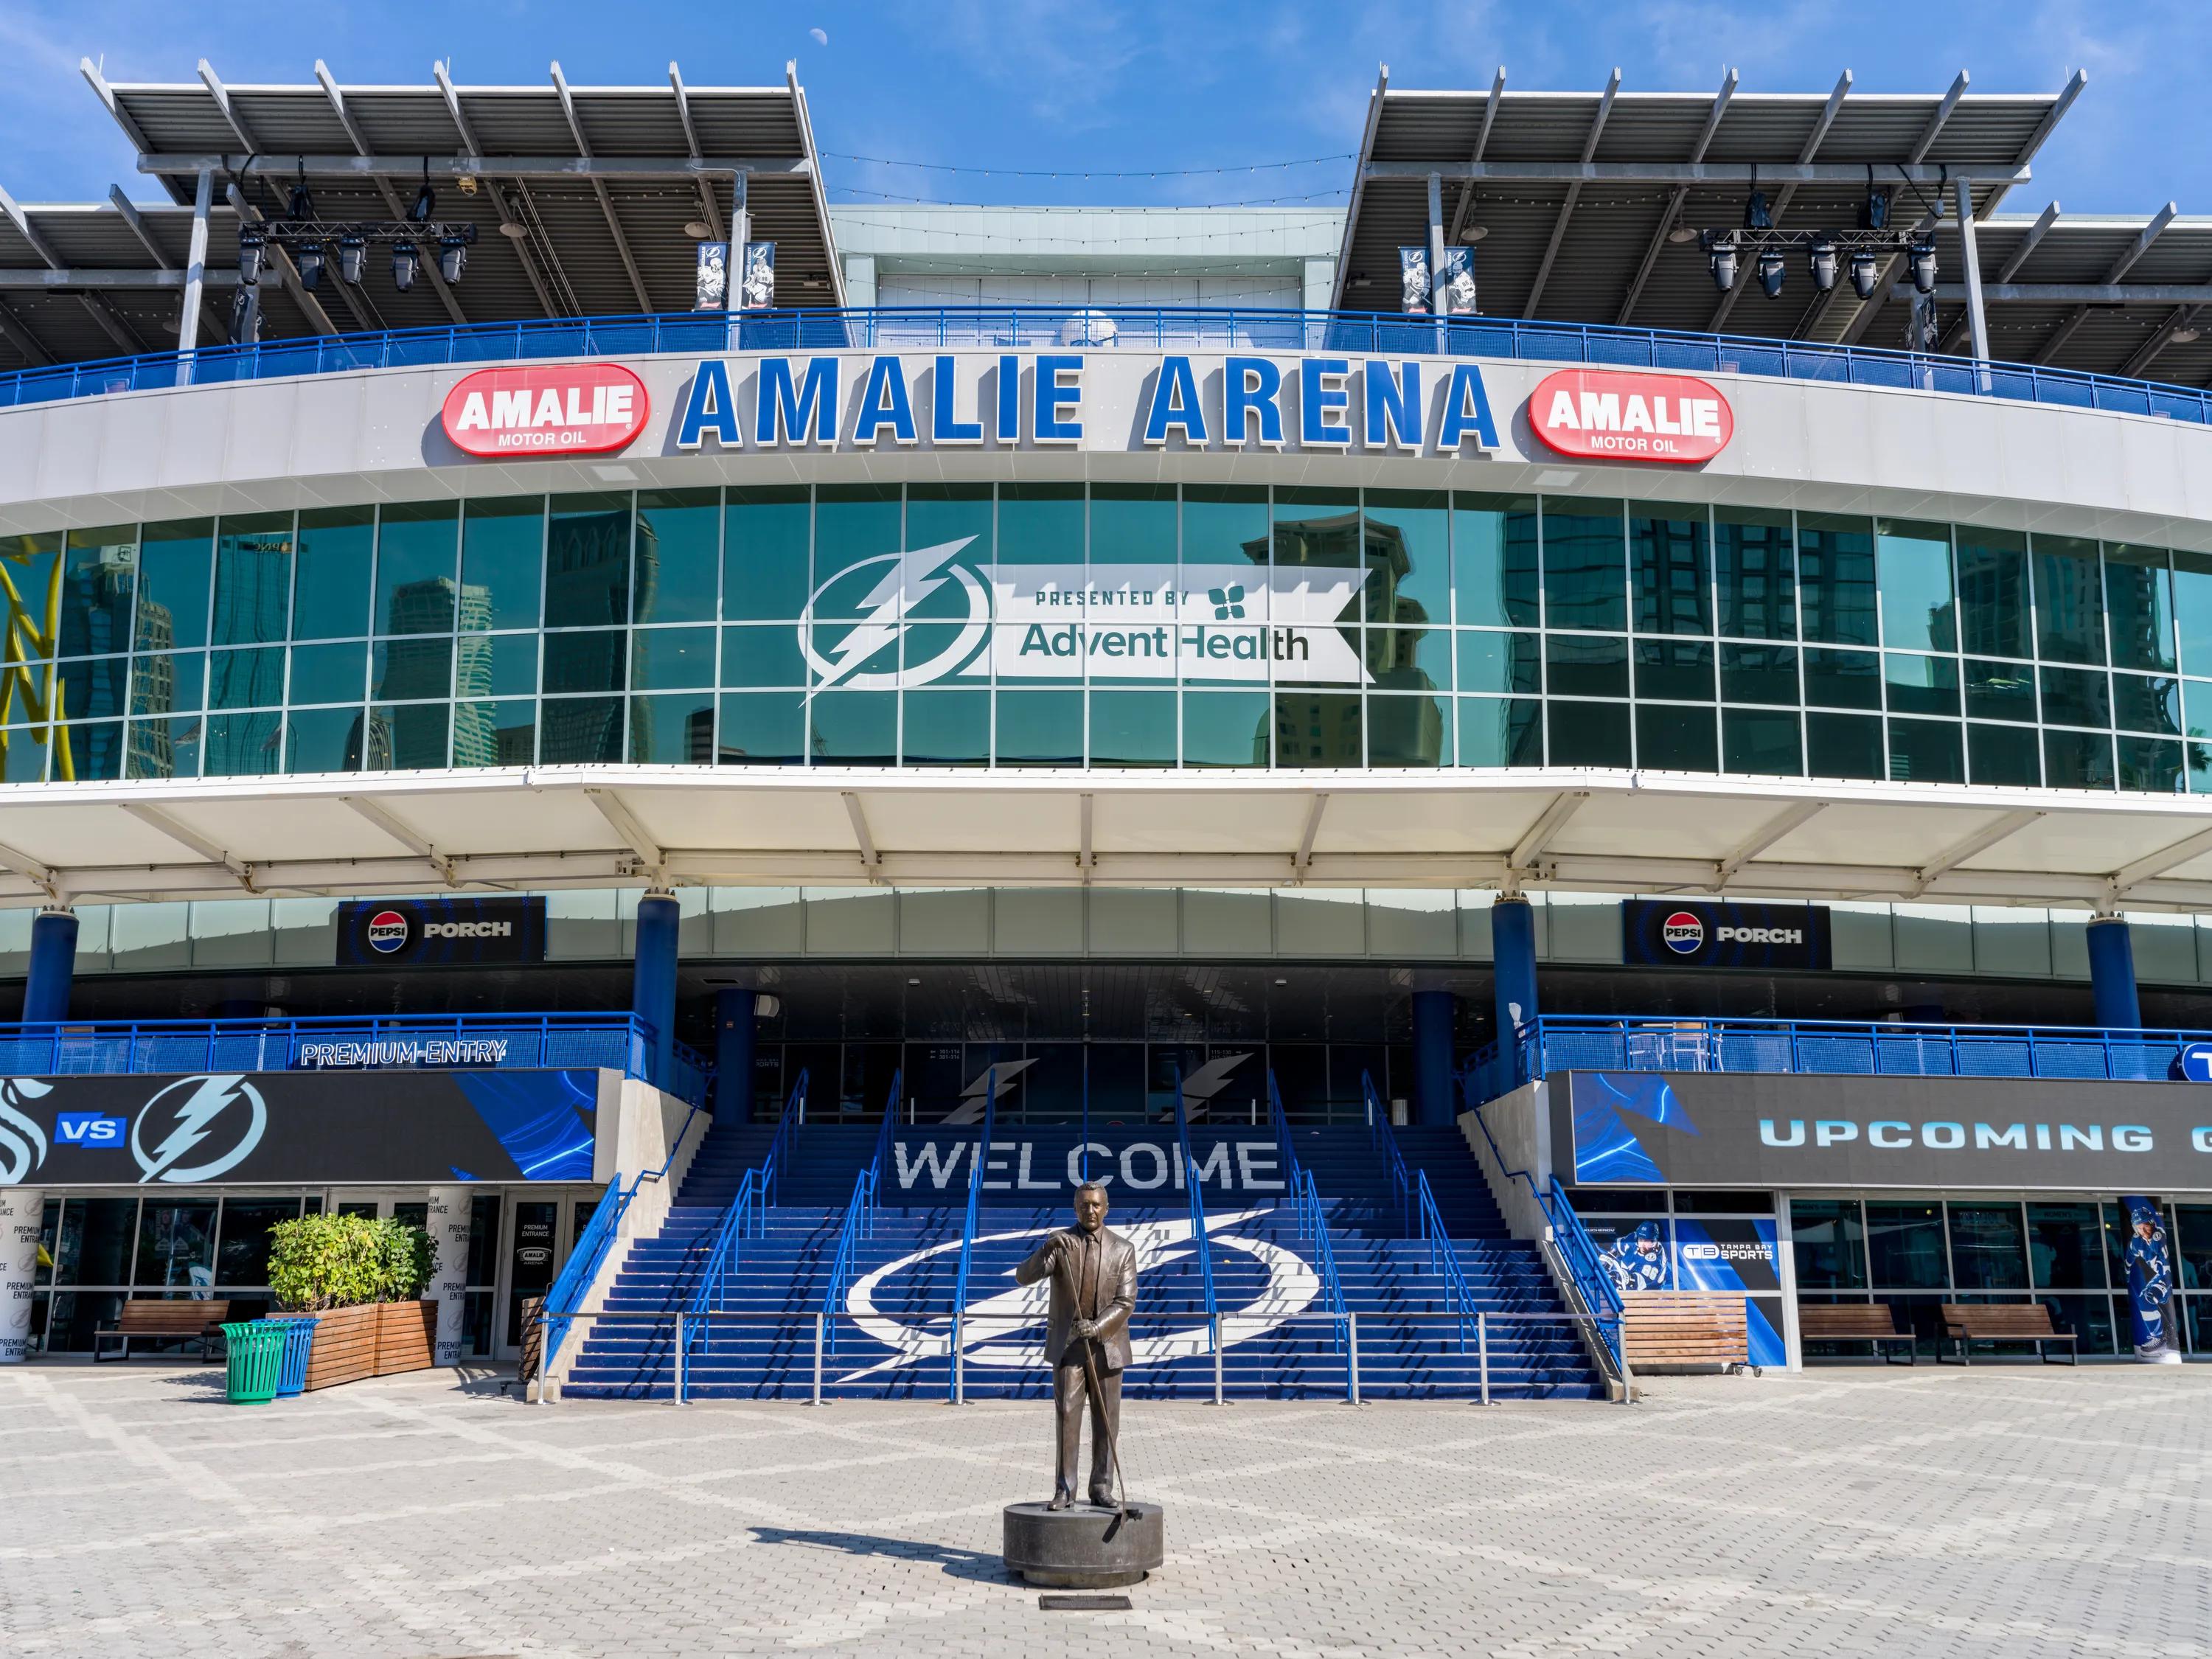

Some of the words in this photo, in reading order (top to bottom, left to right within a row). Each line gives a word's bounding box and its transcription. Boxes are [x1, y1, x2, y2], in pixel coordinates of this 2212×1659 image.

[456, 385, 634, 431] AMALIE
[676, 354, 1085, 449] AMALIE
[1144, 355, 1502, 452] ARENA
[1547, 390, 1721, 437] AMALIE
[498, 433, 555, 447] MOTOR
[560, 431, 587, 444] OIL
[1591, 436, 1648, 451] MOTOR
[1652, 439, 1679, 453] OIL
[1035, 591, 1153, 606] PRESENTED
[1165, 591, 1189, 606] BY
[370, 926, 405, 936] PEPSI
[424, 922, 512, 939] PORCH
[1666, 927, 1701, 938] PEPSI
[1717, 926, 1802, 944] PORCH
[301, 1041, 417, 1065] PREMIUM
[425, 1040, 508, 1063] ENTRY
[61, 1119, 116, 1141] VS
[1759, 1119, 2154, 1152] UPCOMING
[894, 1142, 1285, 1189] WELCOME
[1720, 1250, 1773, 1260] SPORTS
